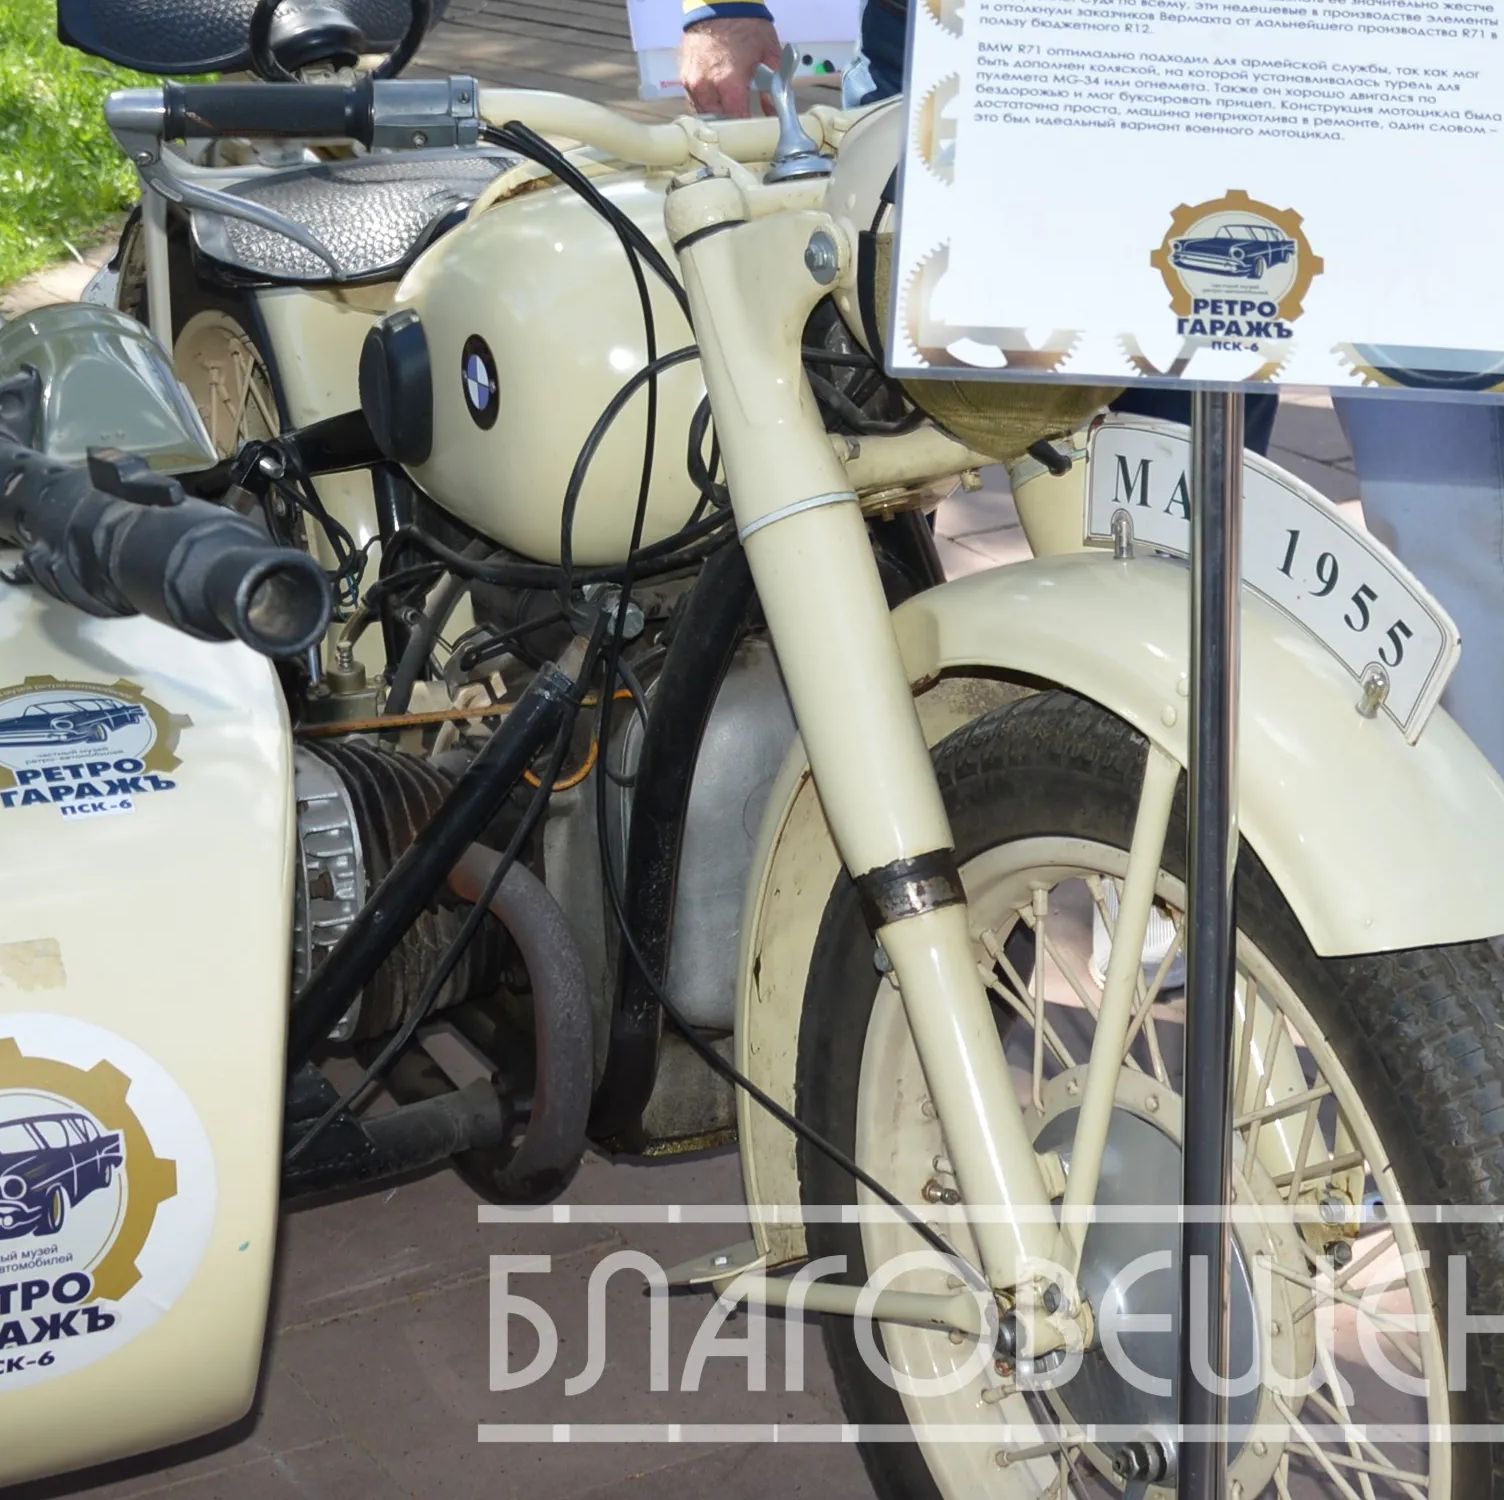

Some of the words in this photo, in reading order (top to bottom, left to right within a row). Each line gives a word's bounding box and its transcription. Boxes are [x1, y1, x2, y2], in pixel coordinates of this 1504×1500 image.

[993, 3, 1072, 17] оттолкнули
[1076, 8, 1154, 21] заказчиков
[1159, 11, 1231, 27] Вермахта
[1254, 16, 1353, 32] дальнейшего
[1357, 23, 1457, 39] производства
[1221, 3, 1307, 16] недешевые
[1322, 8, 1422, 24] производстве
[1426, 14, 1498, 26] элементы
[1442, 2, 1494, 13] жестче
[979, 16, 1027, 28] пользу
[1030, 17, 1120, 32] бюджетного
[1012, 59, 1085, 71] дополнен
[1089, 61, 1160, 76] коляской,
[1188, 67, 1248, 82] которой
[1252, 72, 1380, 89] устанавливалась
[1384, 79, 1432, 92] турель
[1046, 47, 1135, 60] оптимально
[1139, 52, 1209, 65] подходил
[1240, 56, 1327, 73] армейской
[1331, 61, 1391, 76] службы,
[975, 83, 1070, 100] бездорожью
[1118, 90, 1212, 108] буксировать
[1216, 98, 1276, 111] прицеп.
[1280, 100, 1373, 116] Конструкция
[1378, 106, 1460, 119] мотоцикла
[976, 71, 1048, 85] пулемета
[1052, 73, 1099, 86] MG-34
[1134, 79, 1209, 92] огнемета.
[1214, 82, 1258, 95] Также
[1284, 87, 1345, 100] хорошо
[1348, 91, 1413, 103] двигался
[974, 99, 1059, 112] достаточна
[1063, 103, 1121, 116] проста,
[1125, 107, 1190, 118] машина
[1194, 110, 1298, 126] неприхотлива
[1313, 117, 1384, 131] ремонте,
[1428, 123, 1486, 134] словом
[1034, 113, 1116, 129] идеальный
[1120, 120, 1180, 133] вариант
[1185, 124, 1254, 136] военного
[1258, 127, 1344, 141] мотоцикла.
[1193, 298, 1277, 318] РЕТРО
[1177, 318, 1293, 339] ГАРАЖЪ
[1211, 340, 1259, 352] ПСК-6
[1276, 529, 1413, 667] 1955
[15, 758, 143, 786] РЕТРО
[0, 774, 176, 808] ГАРАЖЪ
[60, 798, 133, 816] ПСК-6
[21, 1244, 59, 1261] музей
